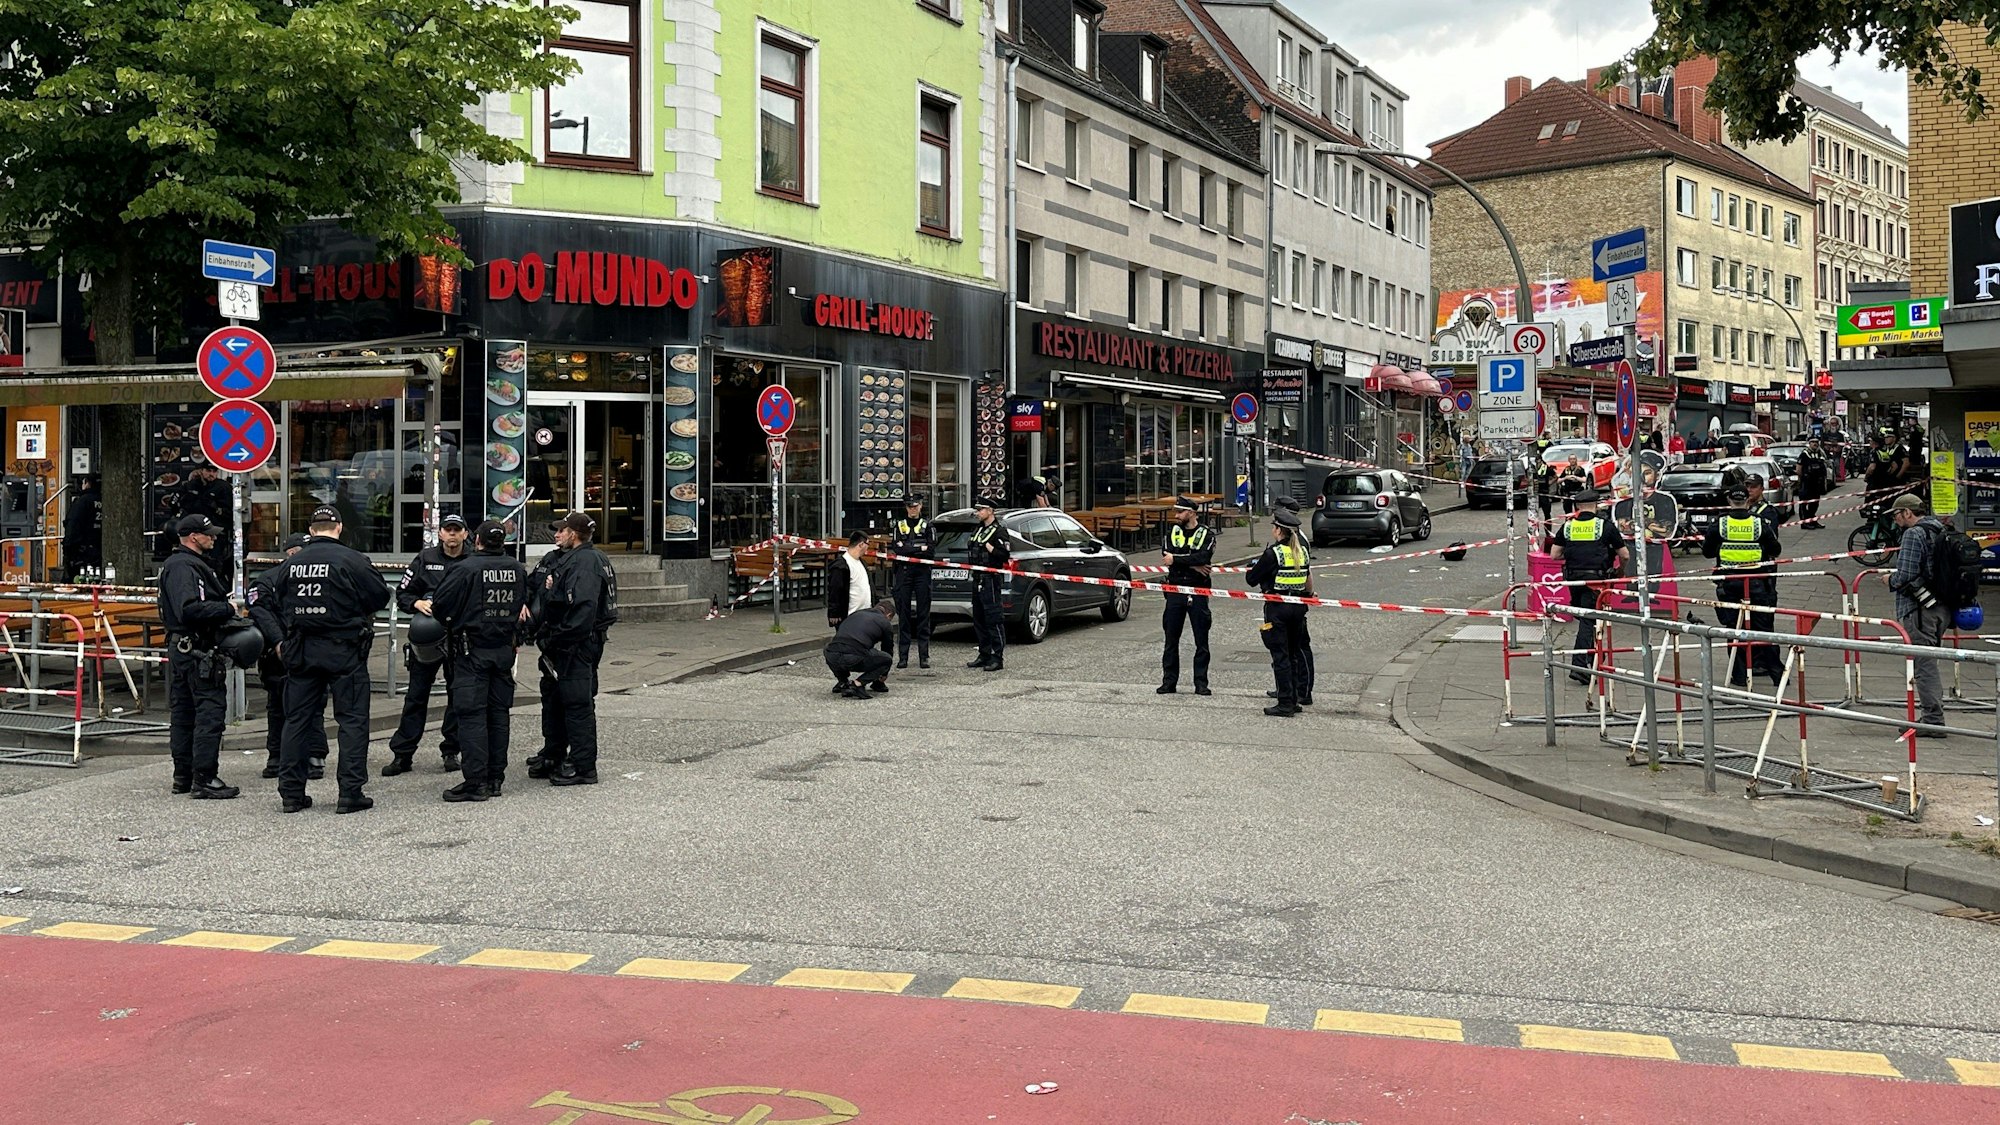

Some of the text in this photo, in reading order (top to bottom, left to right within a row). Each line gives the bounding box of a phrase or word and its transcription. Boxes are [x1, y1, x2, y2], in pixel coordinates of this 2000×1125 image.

[1606, 245, 1643, 263] Einbahnstraße
[208, 254, 255, 269] Einbahnstraße
[488, 251, 698, 309] DO MUNDO
[0, 280, 43, 306] ENT
[815, 293, 934, 341] GRILL-HOUSE
[1520, 335, 1539, 349] 30
[1868, 333, 1880, 342] im
[1882, 331, 1902, 341] Mini
[1041, 321, 1234, 382] RESTAURANT & PIZZERIA
[1465, 340, 1489, 349] ZUM
[1572, 340, 1624, 363] Silbersackstraße
[1262, 369, 1303, 377] RESTAURANT
[1497, 364, 1516, 388] P
[1493, 396, 1522, 405] ZONE
[1016, 403, 1034, 415] sky
[1015, 419, 1035, 429] sport
[1500, 416, 1515, 424] mit
[22, 424, 41, 433] ATM
[1976, 489, 1995, 497] ATM
[1729, 525, 1753, 533] POLIZEI
[3, 571, 31, 584] Cash
[289, 564, 329, 578] POLIZEI
[483, 569, 516, 583] POLIZEI
[297, 583, 322, 597] 212
[487, 589, 514, 603] 2124
